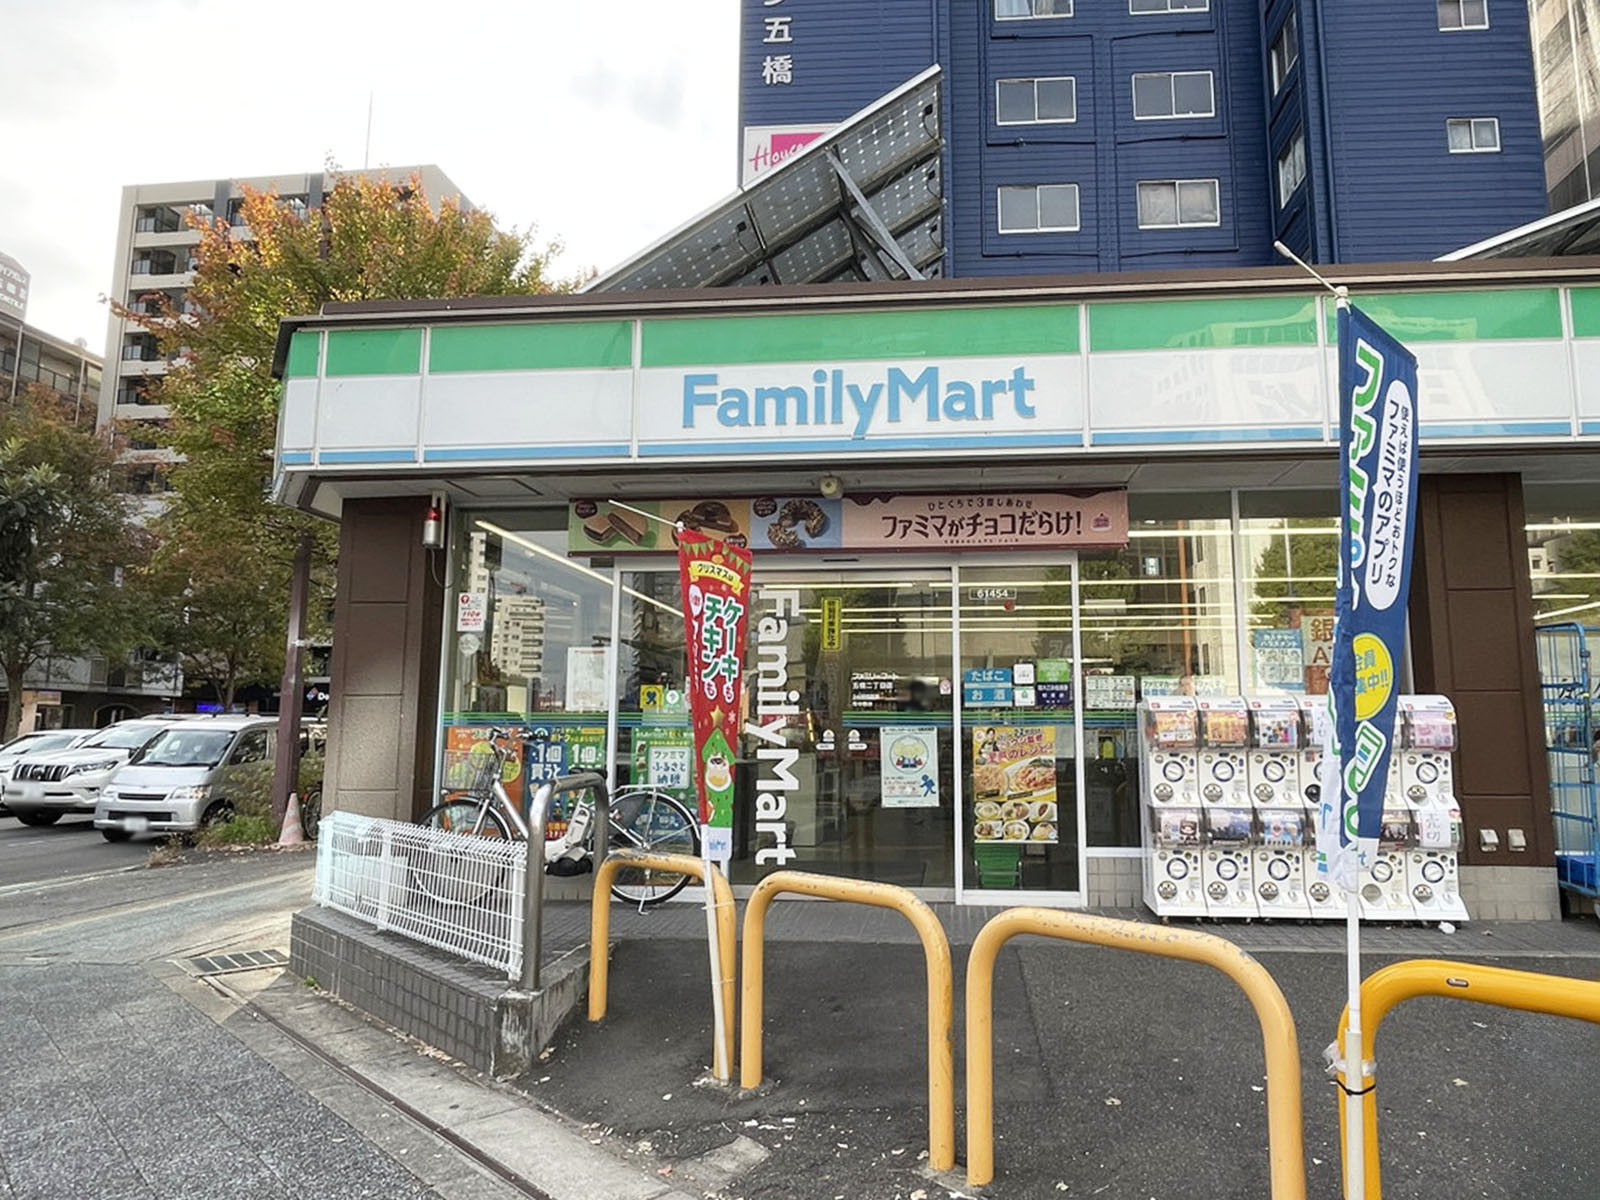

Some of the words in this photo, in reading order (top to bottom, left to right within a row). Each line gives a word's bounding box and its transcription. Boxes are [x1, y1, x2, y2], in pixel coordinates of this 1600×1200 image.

[762, 0, 793, 85] 五橋
[683, 366, 1035, 440] FamilyMart
[1371, 399, 1399, 585] ファミマのアプリ
[977, 589, 1008, 598] 61454
[702, 593, 723, 700] チキンも
[971, 670, 1004, 681] たばこ
[1313, 646, 1333, 663] A
[744, 589, 800, 866] FamilyMart
